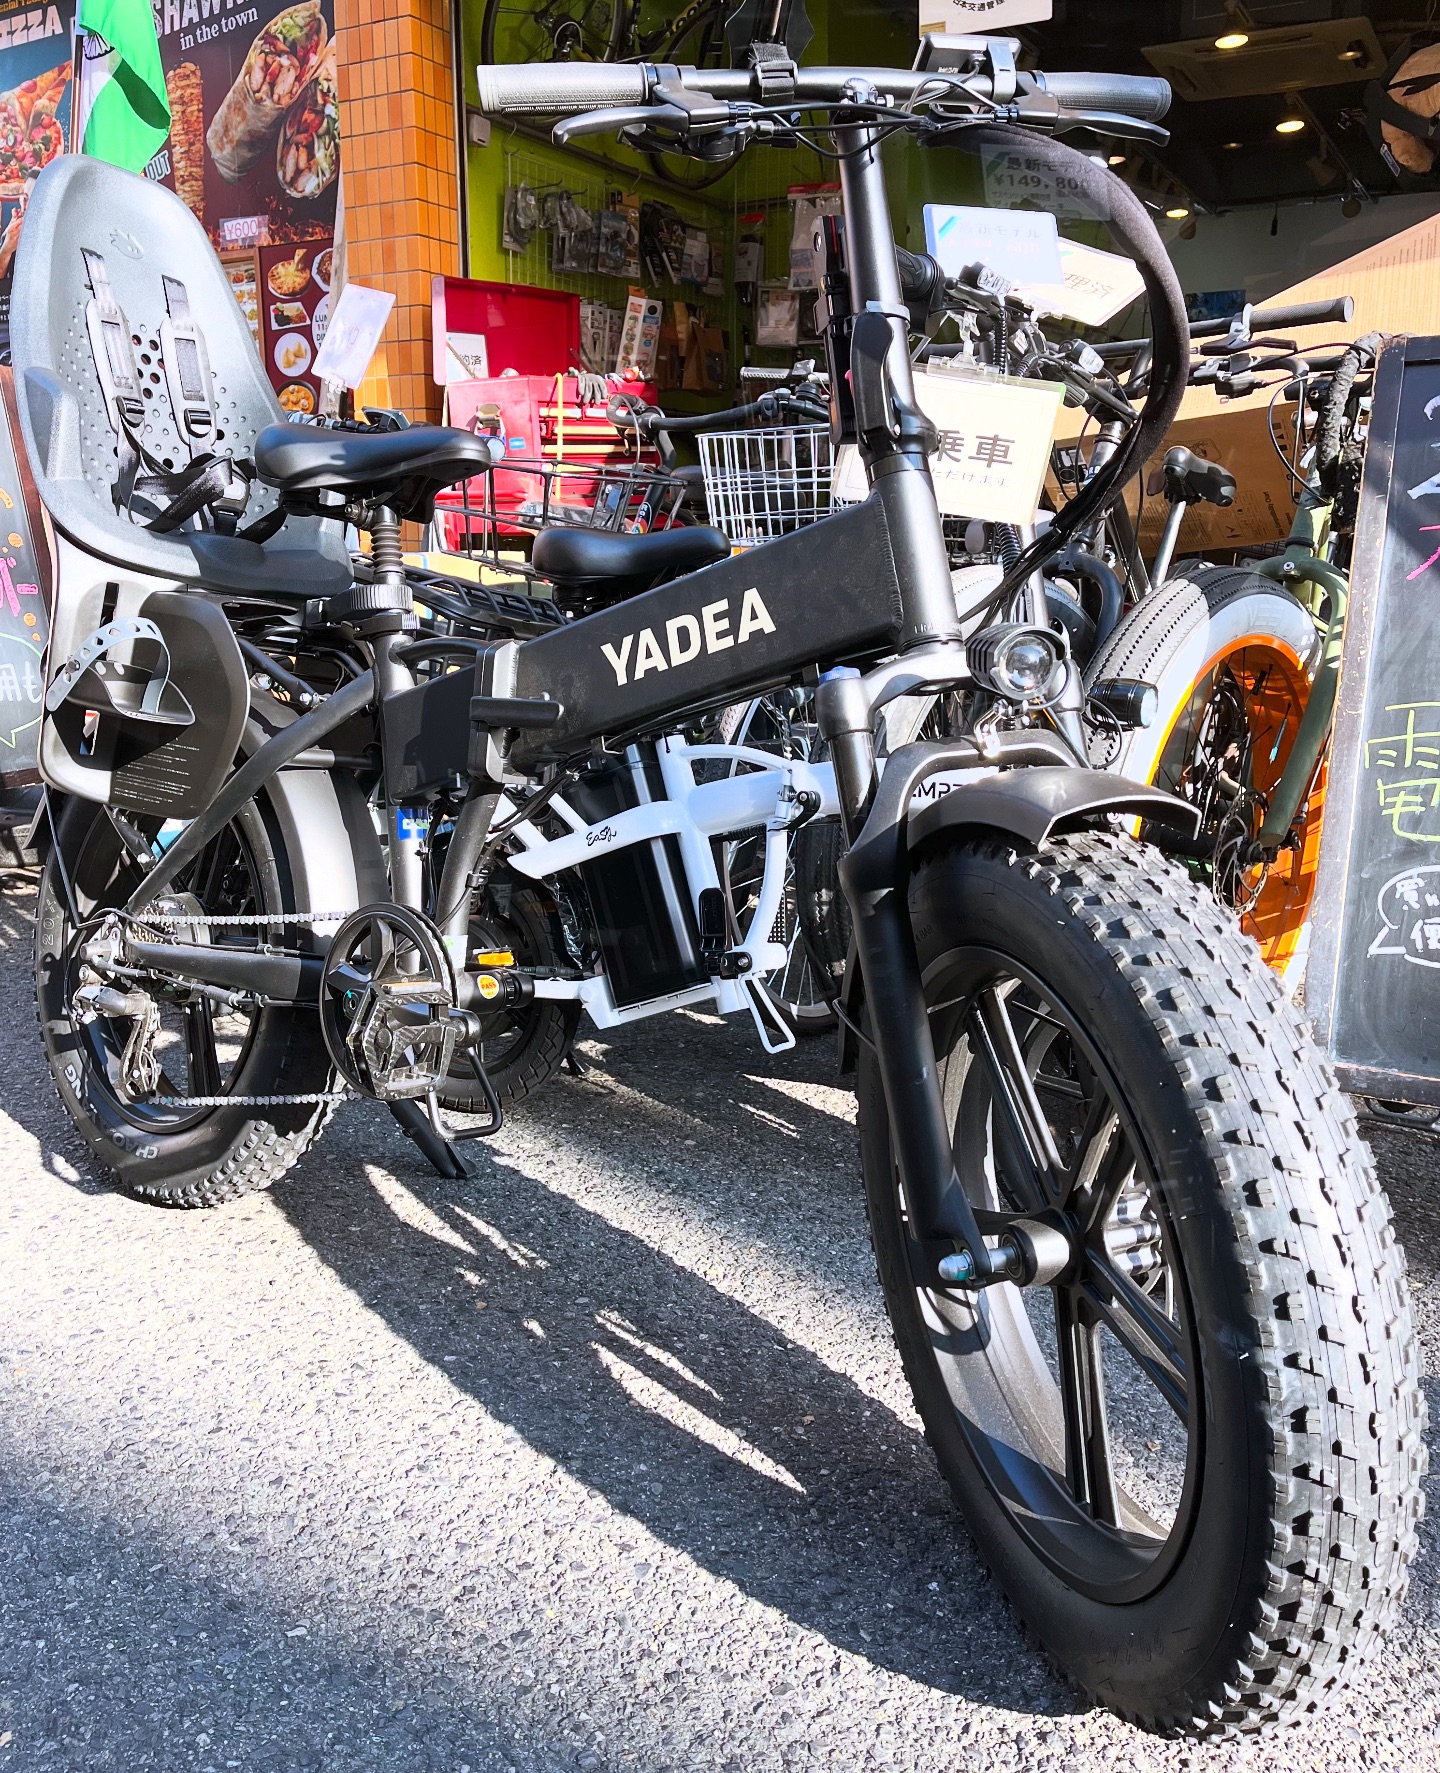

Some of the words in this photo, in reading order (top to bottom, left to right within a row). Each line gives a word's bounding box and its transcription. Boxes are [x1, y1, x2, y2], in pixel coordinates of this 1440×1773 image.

[180, 32, 195, 51] in
[196, 23, 220, 44] the
[221, 7, 259, 34] town
[225, 219, 258, 239] ¥600
[600, 587, 777, 687] YADEA
[481, 981, 497, 991] PASS
